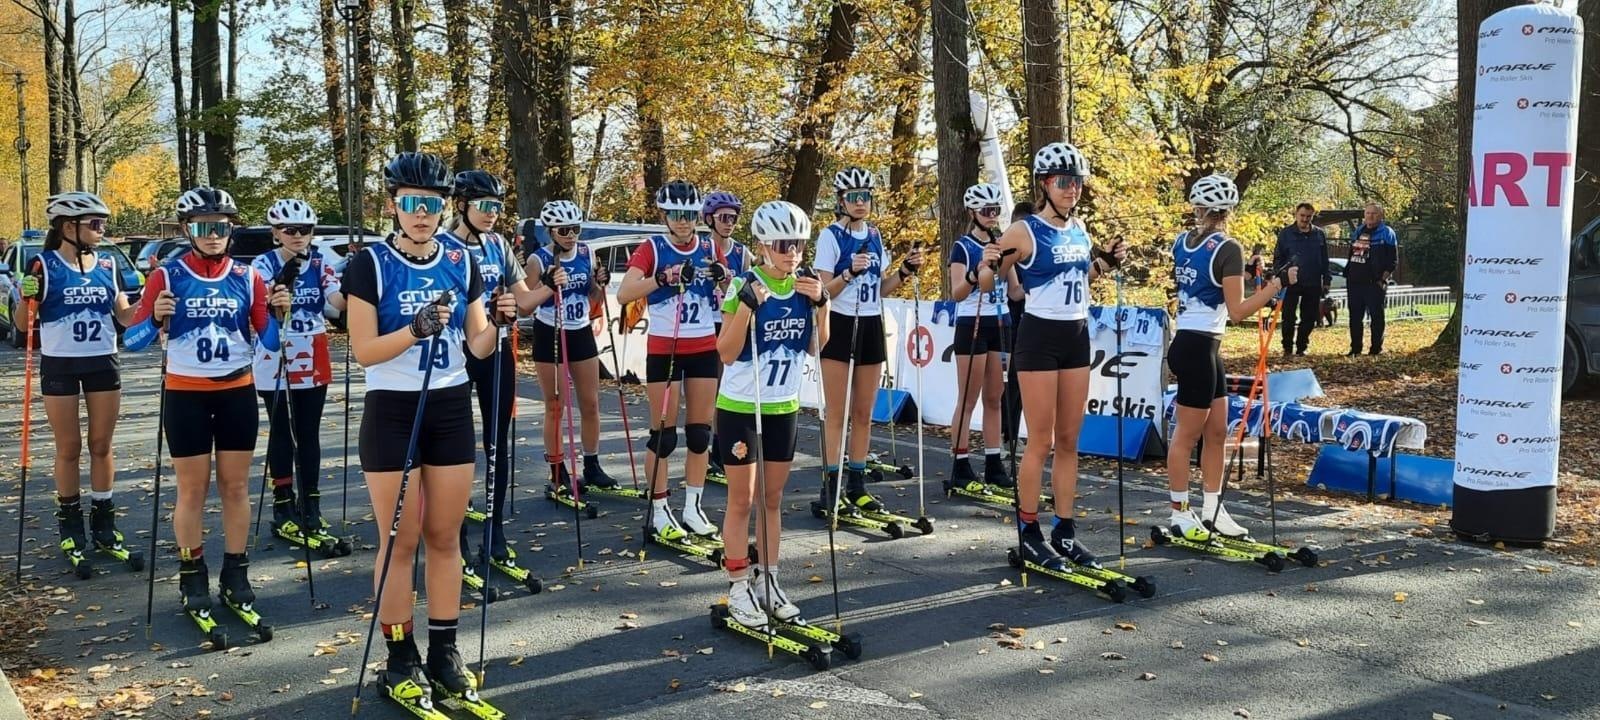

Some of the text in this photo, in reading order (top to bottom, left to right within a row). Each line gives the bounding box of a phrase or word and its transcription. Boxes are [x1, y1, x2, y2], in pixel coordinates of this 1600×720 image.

[1486, 63, 1556, 73] MARWE
[1474, 257, 1543, 265] MARWE
[295, 287, 320, 296] UPA
[860, 282, 877, 303] 81
[1063, 281, 1082, 305] 76
[291, 295, 320, 305] ZOTY
[566, 302, 584, 321] 88
[73, 320, 102, 342] 92
[1136, 319, 1150, 334] 78
[1470, 328, 1539, 338] MARWE
[196, 337, 230, 362] 84
[766, 360, 791, 386] 77
[1466, 398, 1535, 408] MARWE
[1463, 466, 1531, 478] MARWE
